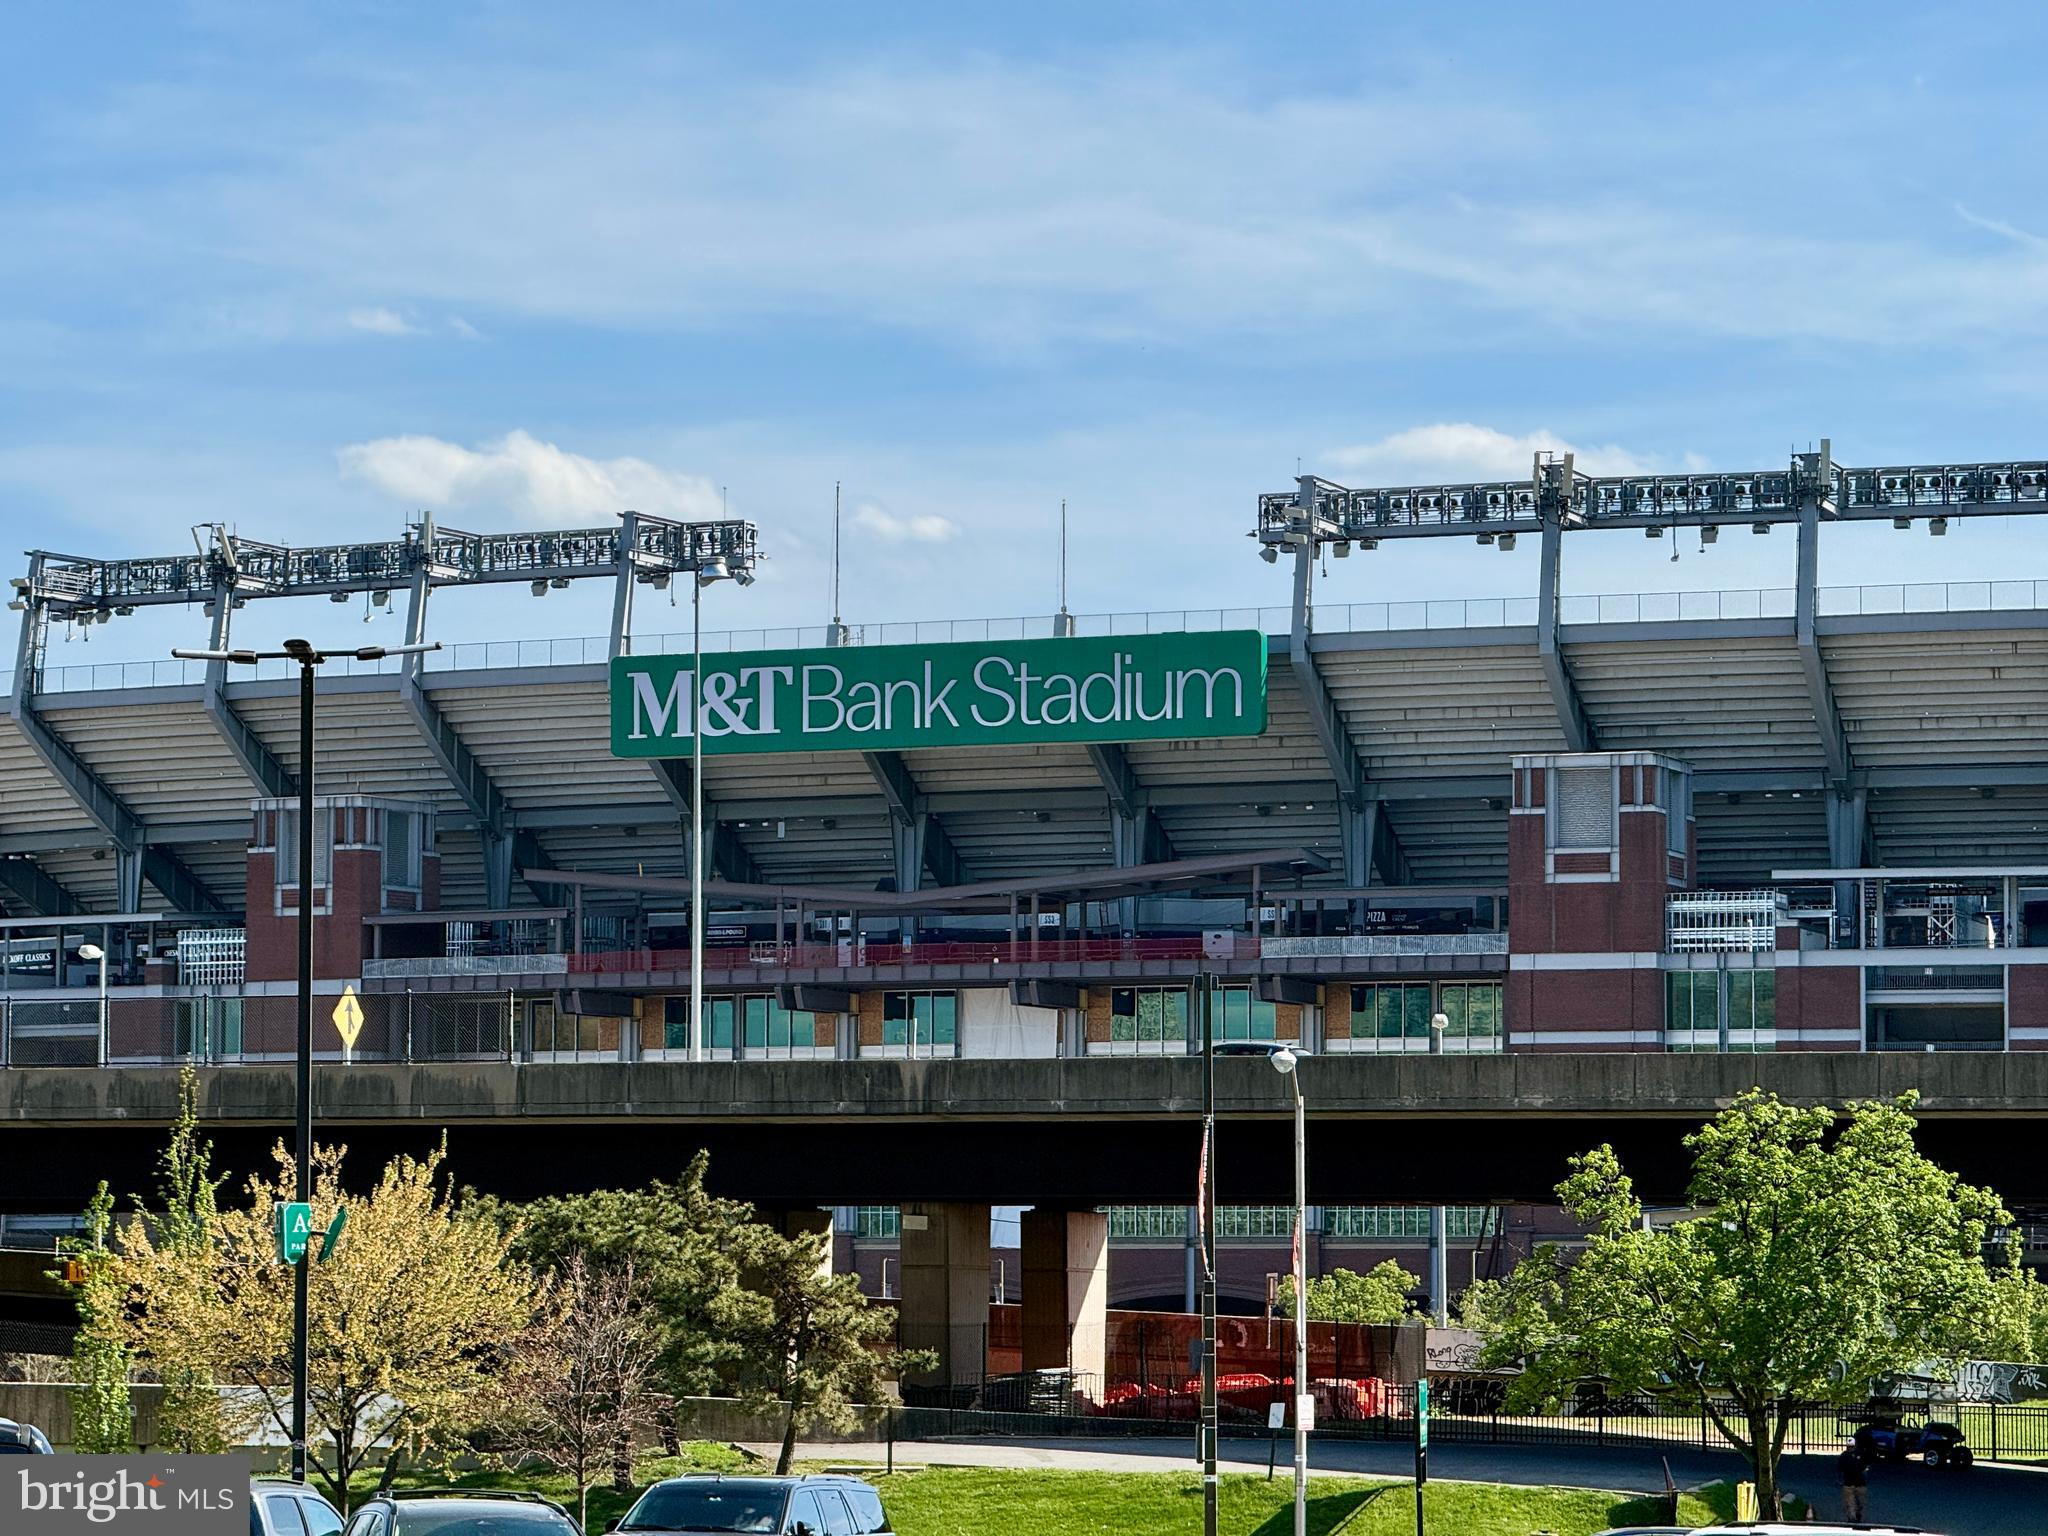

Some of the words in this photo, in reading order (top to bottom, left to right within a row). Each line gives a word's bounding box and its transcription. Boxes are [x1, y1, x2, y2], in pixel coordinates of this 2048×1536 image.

[627, 666, 793, 739] M&T
[802, 660, 960, 732] Bank
[970, 652, 1242, 727] Stadium
[1366, 911, 1386, 922] PIZZA
[25, 952, 51, 962] CLASSICS
